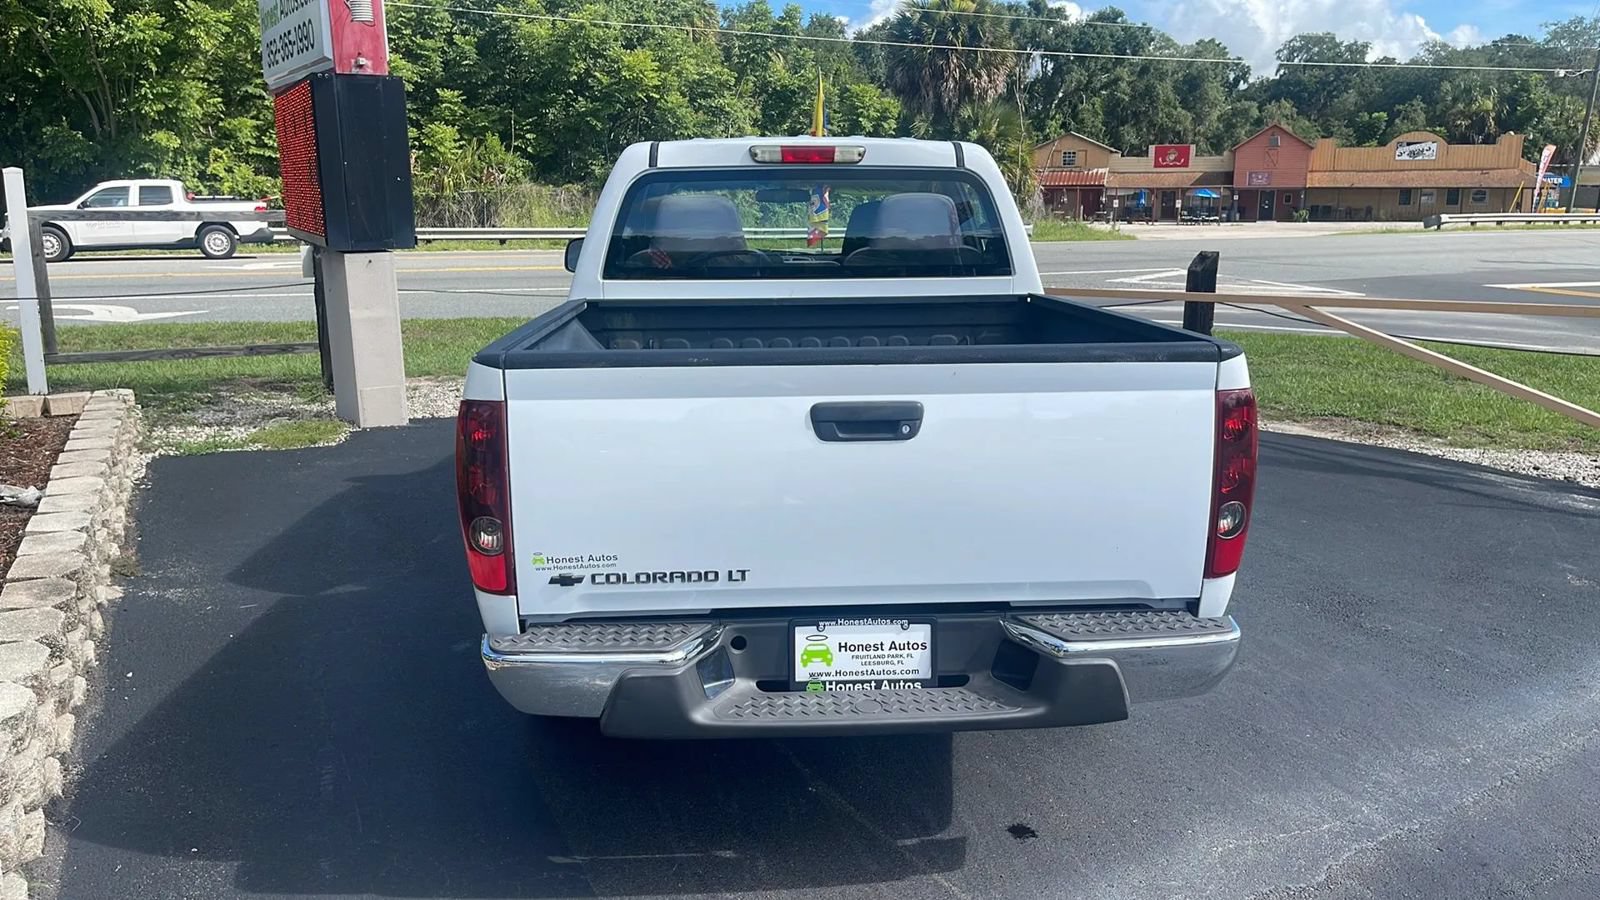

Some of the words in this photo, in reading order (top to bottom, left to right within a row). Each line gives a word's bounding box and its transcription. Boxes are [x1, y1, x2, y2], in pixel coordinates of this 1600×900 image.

[266, 18, 315, 68] 352-365-1990
[546, 555, 584, 564] Honest
[587, 554, 618, 562] Autos
[535, 562, 617, 571] www.HonestAutos.com
[590, 570, 720, 585] COLORADO
[727, 569, 751, 582] LT
[818, 618, 908, 627] www.HonestAutos.com
[838, 641, 885, 653] Honest
[888, 640, 928, 652] Autos
[808, 668, 920, 678] www.HonestAutos.com
[825, 680, 876, 691] Honest
[881, 680, 922, 691] Autos
